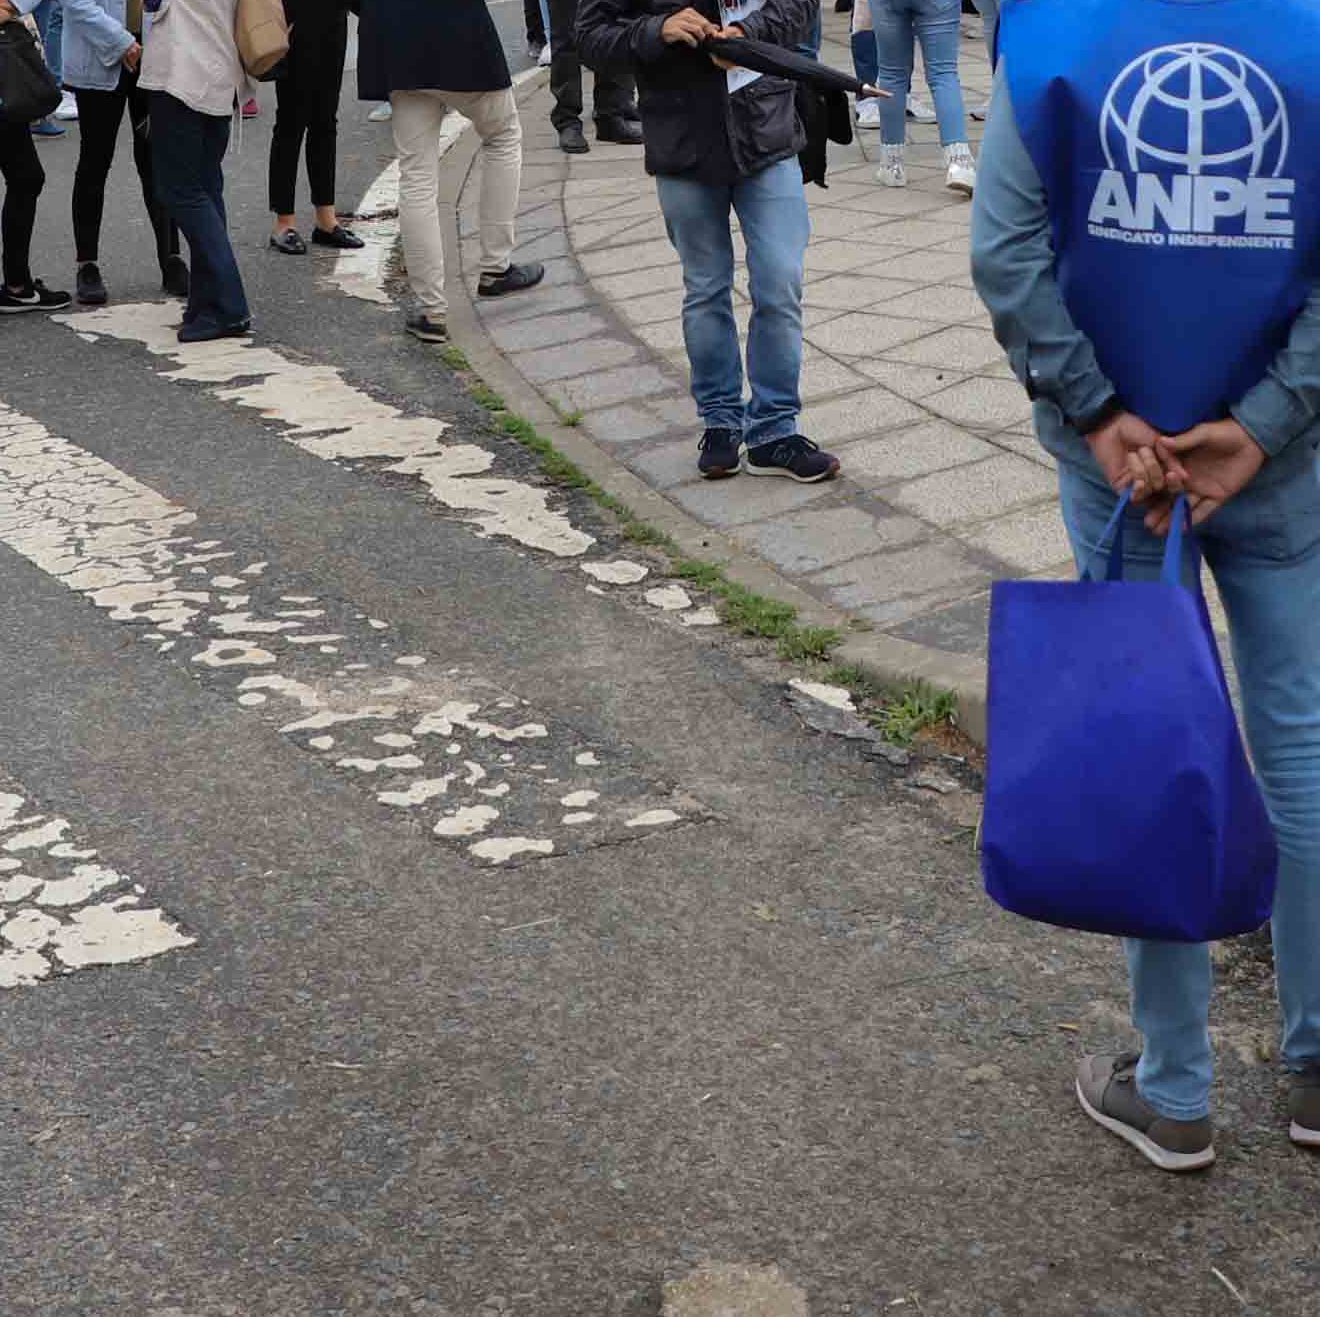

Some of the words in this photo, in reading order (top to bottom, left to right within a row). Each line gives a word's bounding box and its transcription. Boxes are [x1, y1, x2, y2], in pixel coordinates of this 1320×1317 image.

[1087, 169, 1295, 235] ANPE
[1087, 223, 1165, 246] SINDICATO
[1168, 233, 1295, 250] INDEPENDIENTE
